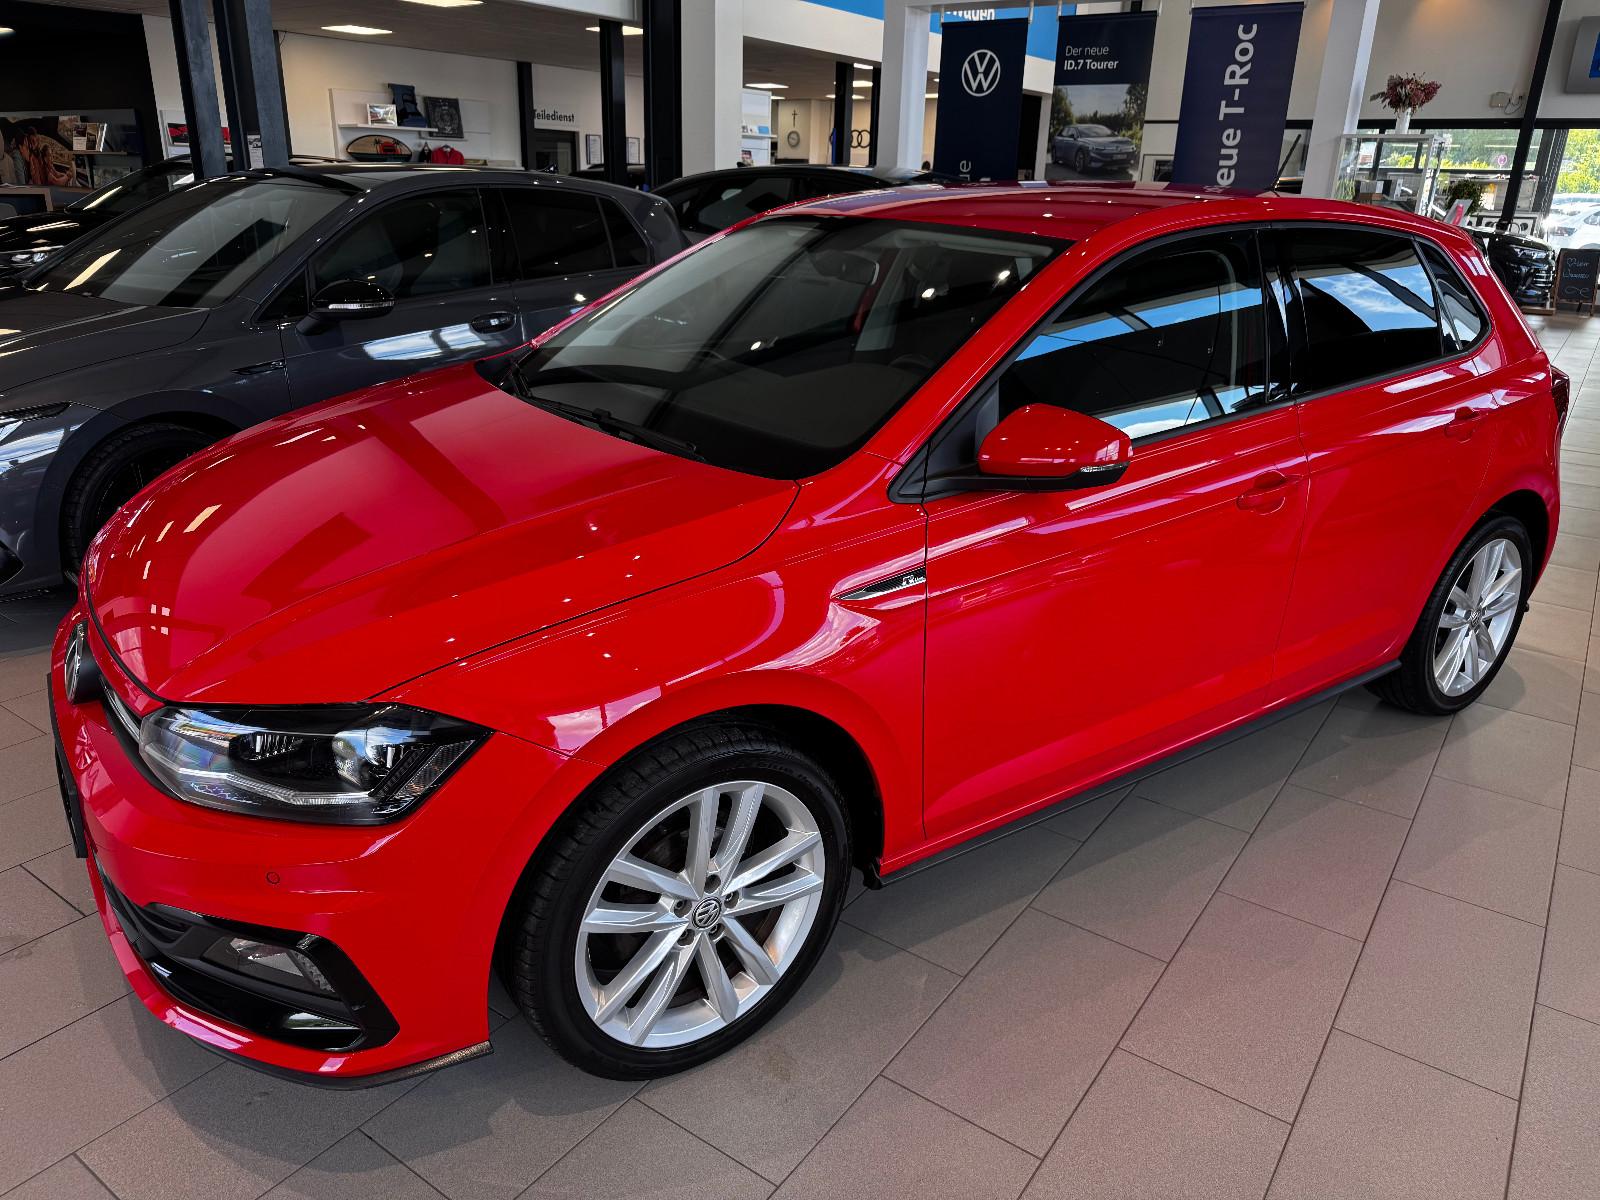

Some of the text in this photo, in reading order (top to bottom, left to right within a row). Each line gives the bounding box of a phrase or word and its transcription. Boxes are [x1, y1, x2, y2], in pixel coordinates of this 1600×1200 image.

[1063, 58, 1120, 71] ID.7 Tourer
[1065, 45, 1109, 56] Der neue
[962, 49, 1001, 96] VW
[1216, 23, 1258, 189] eue T-Roc
